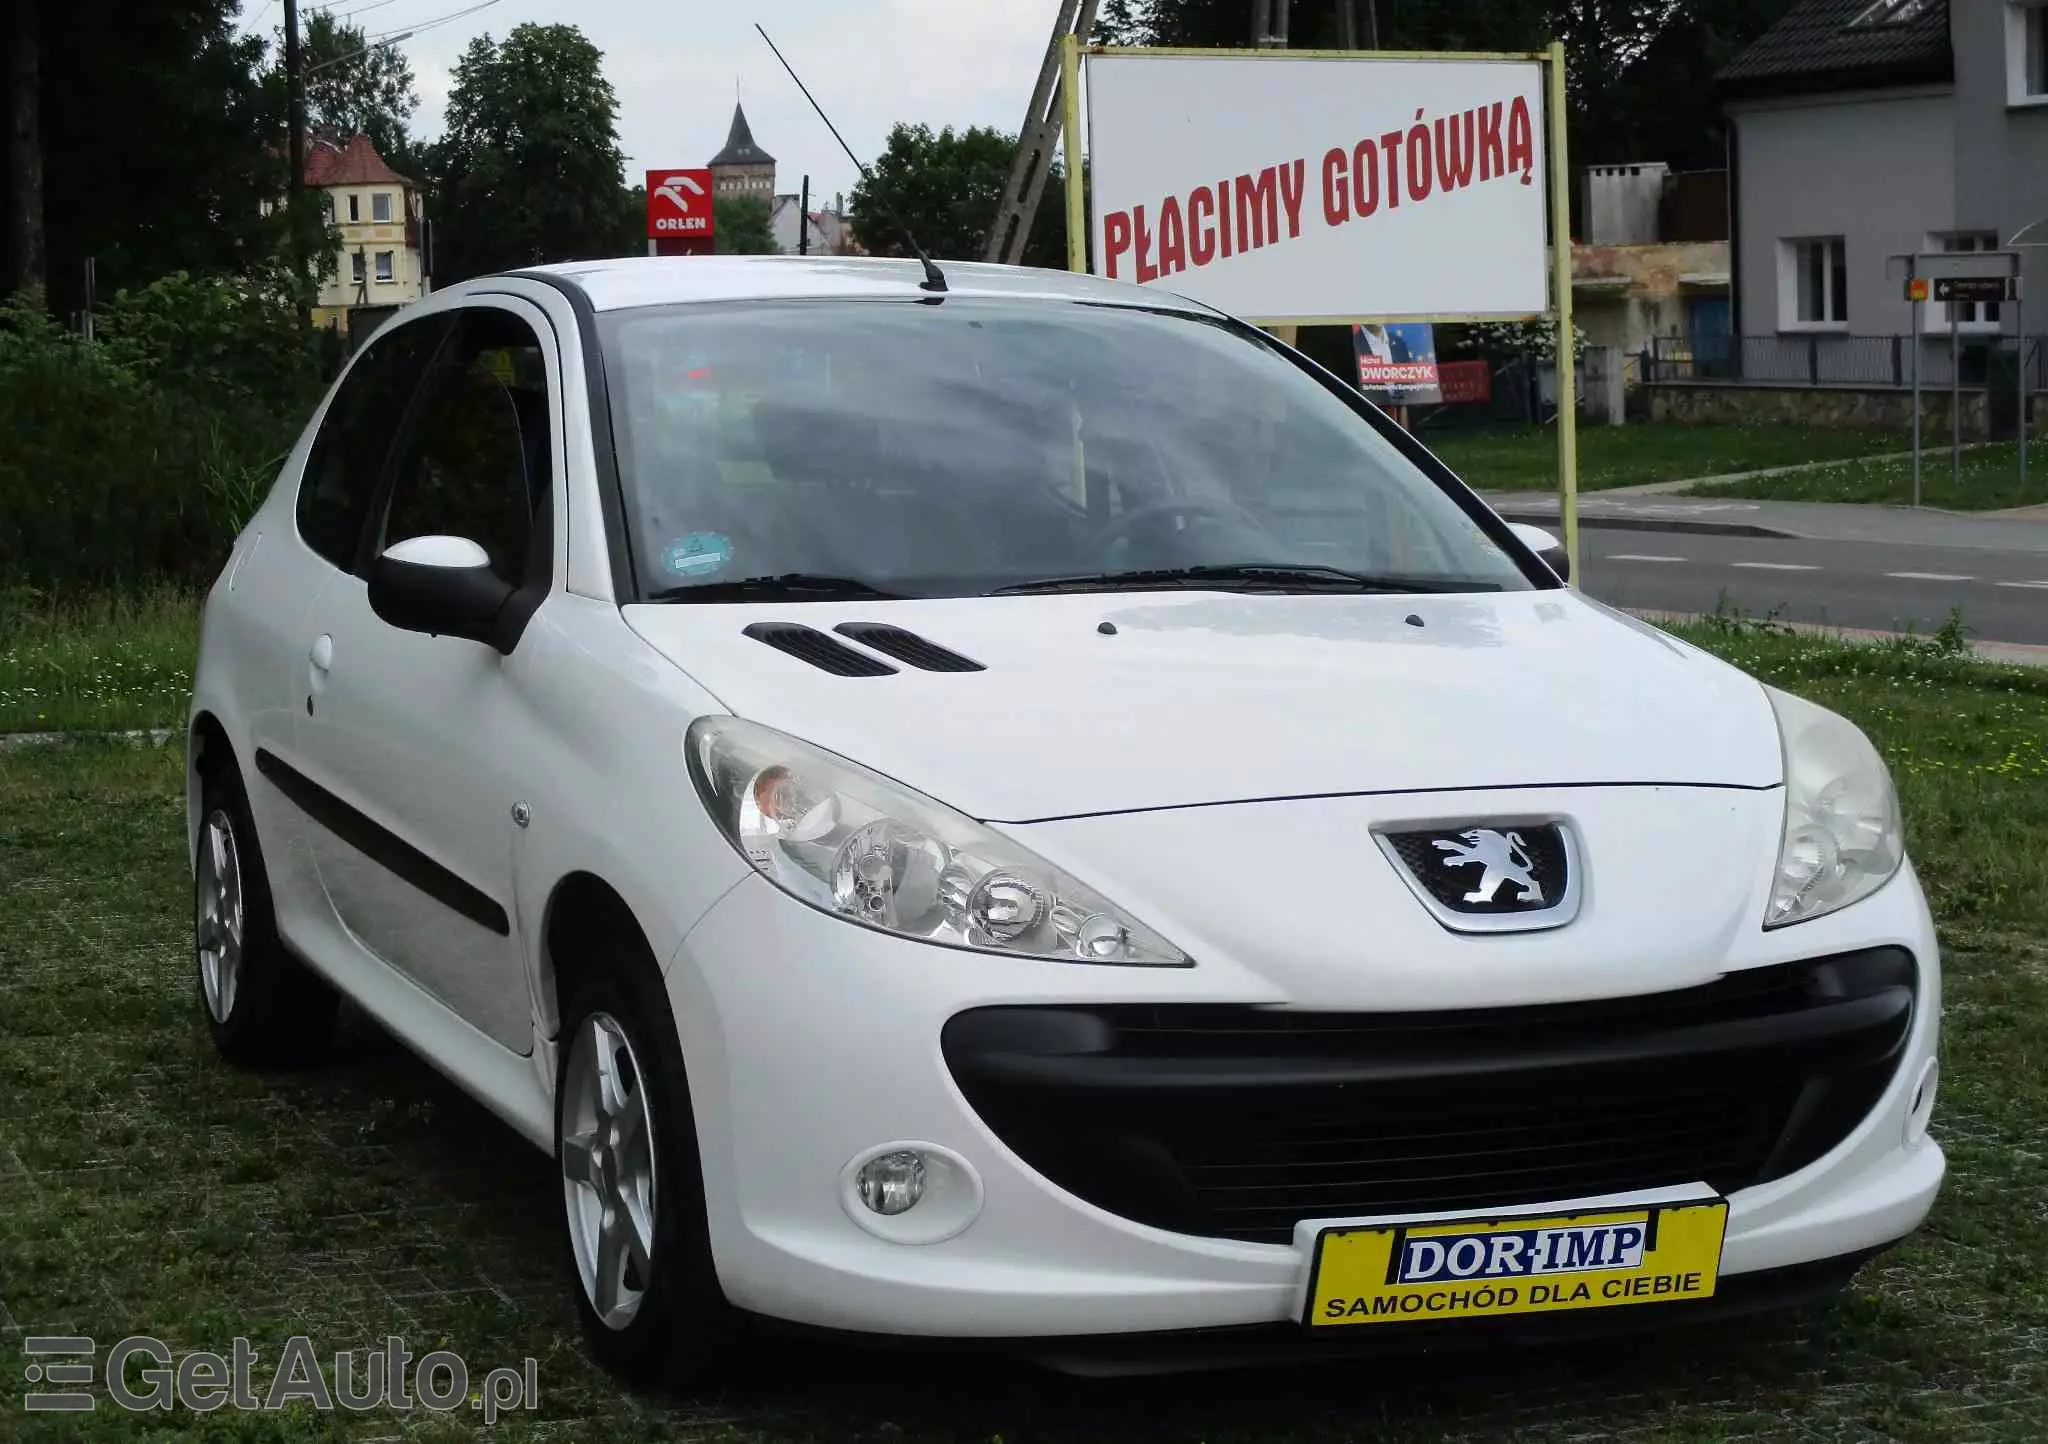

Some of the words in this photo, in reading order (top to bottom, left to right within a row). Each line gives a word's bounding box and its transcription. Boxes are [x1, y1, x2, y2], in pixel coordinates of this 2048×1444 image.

[1104, 158, 1305, 284] PŁACIMY
[1322, 94, 1533, 227] GOTÓWKĄ
[656, 217, 705, 230] ORLEN
[1361, 366, 1434, 380] DWORCZYK
[1325, 1285, 1519, 1318] SAMOCHÓD
[1528, 1284, 1591, 1306] DLA
[1601, 1272, 1702, 1299] CIEBIE
